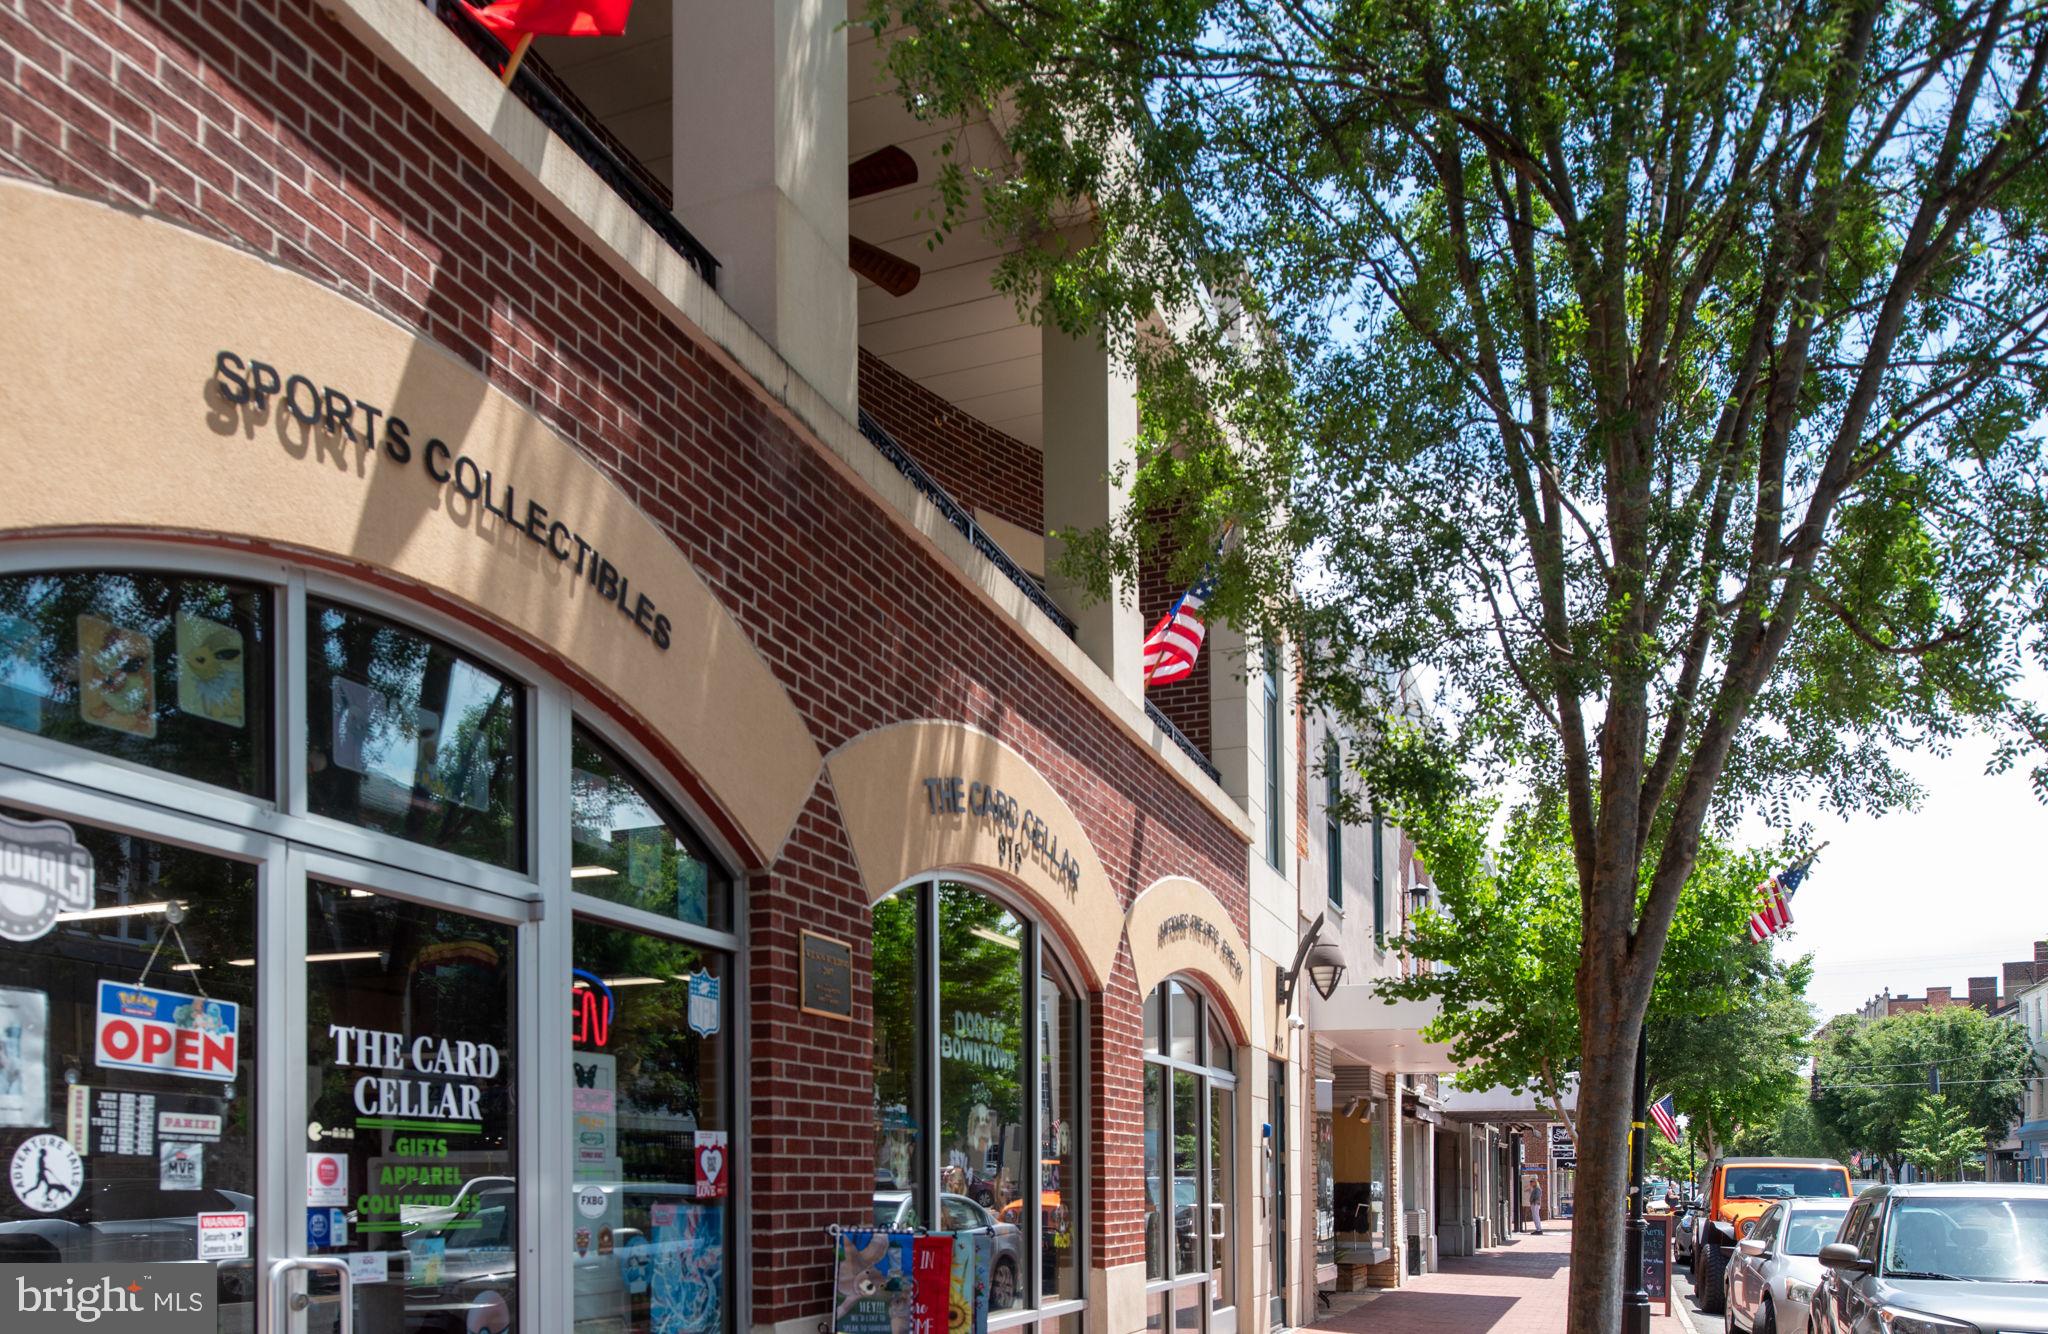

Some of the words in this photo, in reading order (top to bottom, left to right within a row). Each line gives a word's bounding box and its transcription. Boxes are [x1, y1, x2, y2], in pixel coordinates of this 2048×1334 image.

[216, 351, 411, 464] SPORTS
[425, 438, 672, 651] COLLECTIBLES
[924, 776, 966, 816] THE
[969, 782, 1019, 831] CARD
[1023, 809, 1080, 890] CELLAR
[102, 1019, 235, 1073] OPEN
[329, 1024, 404, 1071] THE
[412, 1035, 500, 1079] CARD
[941, 1033, 1016, 1072] DOWNTOWN
[353, 1076, 483, 1120] CELLAR
[164, 1117, 217, 1130] PANINI
[396, 1138, 448, 1158] GIFTS
[14, 1137, 64, 1188] ADVENTURE
[66, 1150, 81, 1187] TAILS
[168, 1160, 194, 1175] MVP
[380, 1166, 463, 1186] APPAREL
[357, 1194, 481, 1214] COLLECTIBLES
[581, 1195, 604, 1206] FXBG
[202, 1215, 244, 1228] WARNING
[920, 1250, 935, 1269] IN
